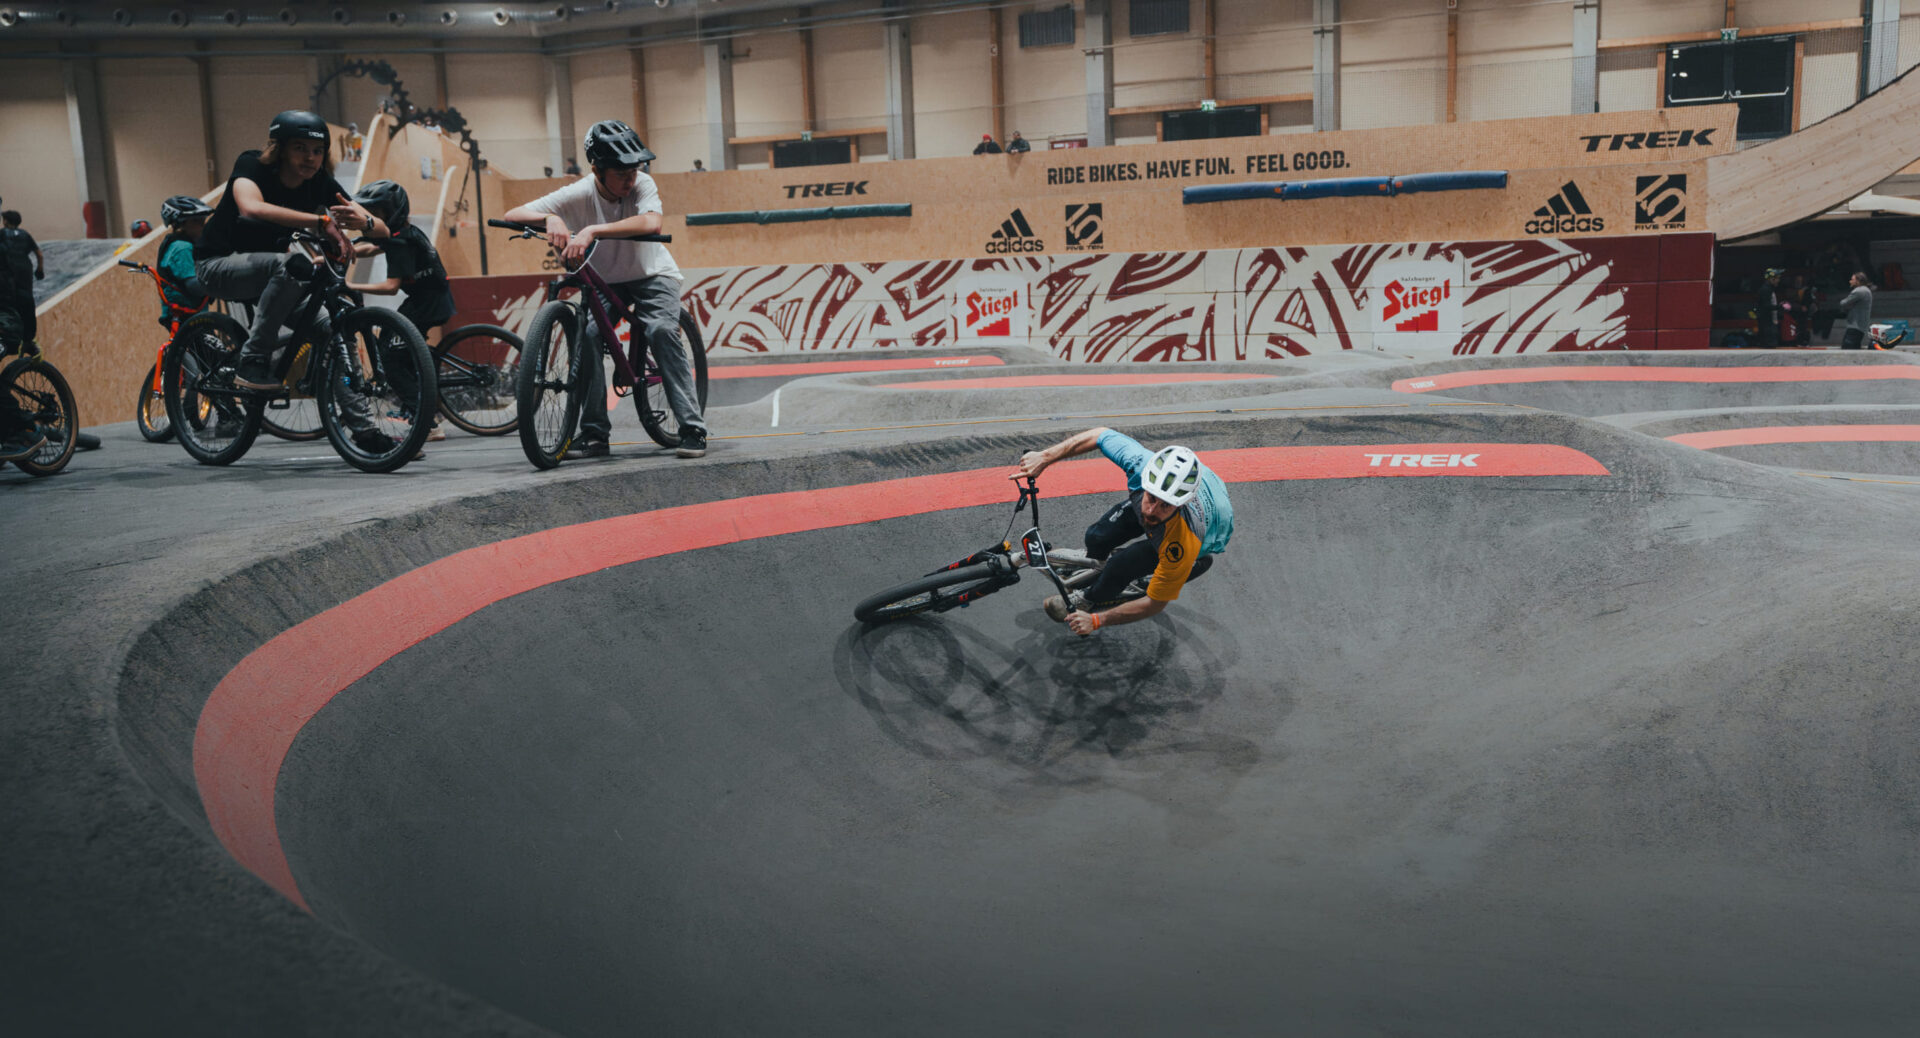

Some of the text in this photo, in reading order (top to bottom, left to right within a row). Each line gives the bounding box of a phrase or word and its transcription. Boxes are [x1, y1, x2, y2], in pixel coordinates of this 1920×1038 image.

[1579, 128, 1718, 152] TREK
[1047, 150, 1351, 185] RIDE BIKES. HAVE FUN. FEEL GOOD.
[782, 181, 870, 199] TREK
[1524, 214, 1604, 235] adidas
[1635, 222, 1686, 231] FIVE TEN
[985, 236, 1045, 255] adidas
[966, 289, 1019, 329] Stiegl
[1382, 278, 1451, 322] Stiegl
[1363, 453, 1481, 468] TREK
[1028, 541, 1043, 556] 27
